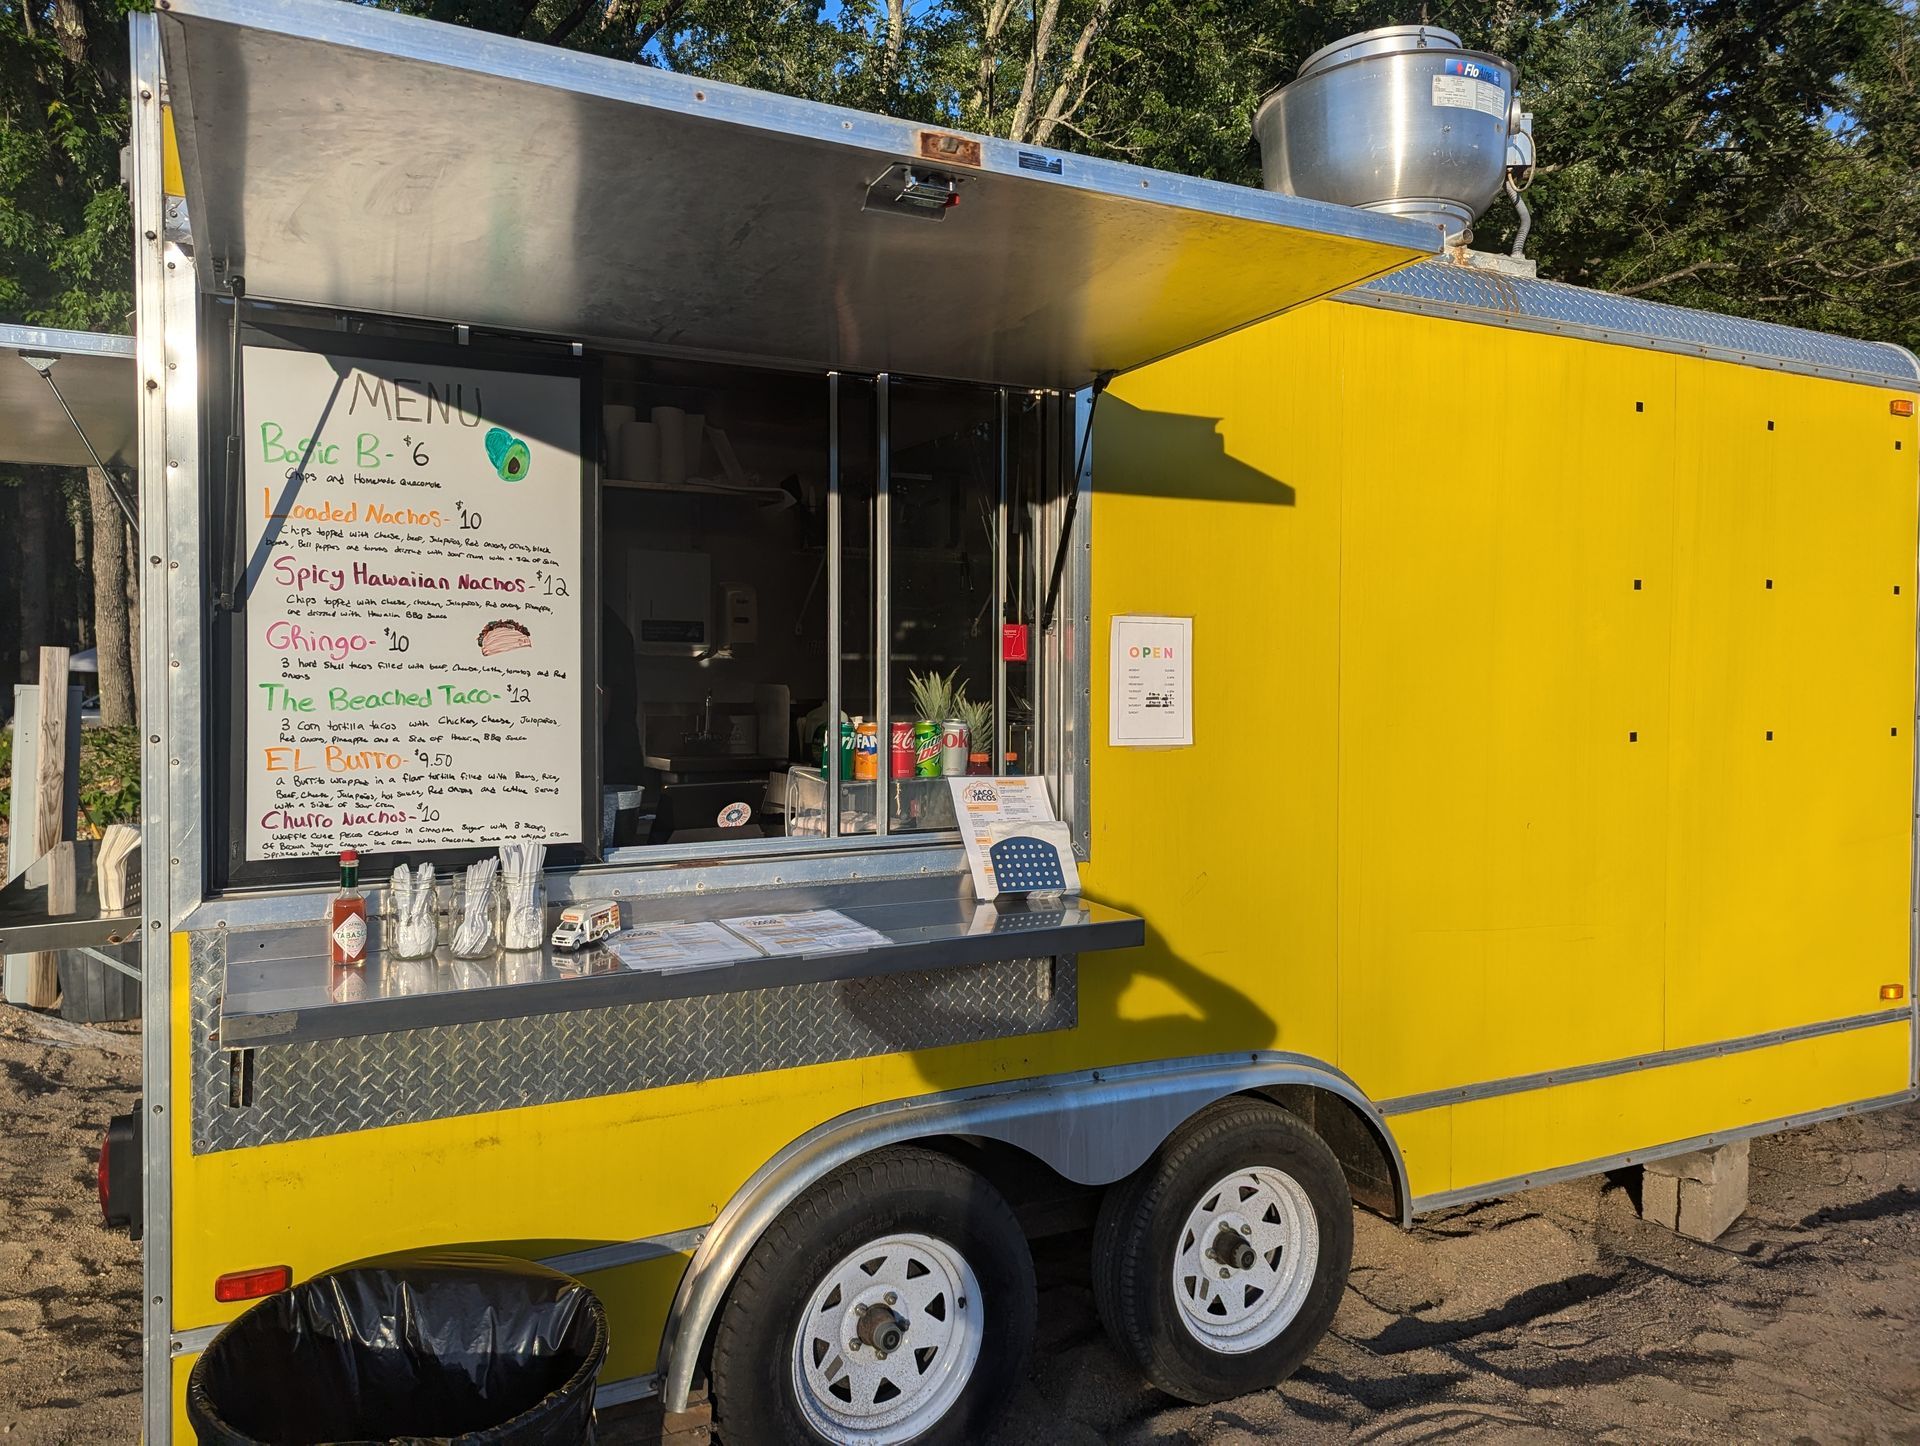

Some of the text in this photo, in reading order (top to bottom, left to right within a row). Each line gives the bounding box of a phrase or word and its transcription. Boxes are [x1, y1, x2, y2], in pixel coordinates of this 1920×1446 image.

[349, 373, 482, 427] MENU
[261, 422, 339, 464] Basic
[403, 435, 429, 466] $6
[285, 467, 317, 483] Chips
[326, 474, 344, 485] and
[264, 487, 357, 523] Loaded
[455, 500, 482, 530] $10
[280, 524, 312, 537] Chips
[316, 527, 344, 540] topped
[465, 538, 479, 547] Red
[297, 539, 311, 548] Bell
[273, 555, 344, 591] Spicy
[353, 561, 450, 590] Hawaiian
[535, 570, 570, 597] $12
[286, 594, 317, 606] Chips
[323, 596, 351, 608] topped
[356, 598, 377, 606] with
[340, 609, 362, 618] with
[384, 627, 409, 652] $10
[1129, 646, 1173, 658] OPEN
[280, 657, 290, 669] 3
[298, 658, 318, 668] hard
[349, 661, 373, 670] tacos
[407, 662, 424, 670] with
[536, 669, 550, 677] and
[259, 683, 317, 712] The
[328, 687, 432, 711] Beached
[506, 684, 531, 703] $12
[281, 718, 290, 731] 3
[326, 720, 365, 731] tortilla
[369, 720, 397, 730] tacos
[408, 720, 429, 728] with
[279, 732, 296, 743] Red
[414, 748, 453, 768] $9.50
[293, 774, 326, 787] Burrito
[374, 776, 384, 785] in
[487, 772, 508, 781] with
[381, 790, 394, 800] hot
[274, 801, 295, 809] with
[261, 810, 333, 830] Churro
[416, 802, 440, 822] $10
